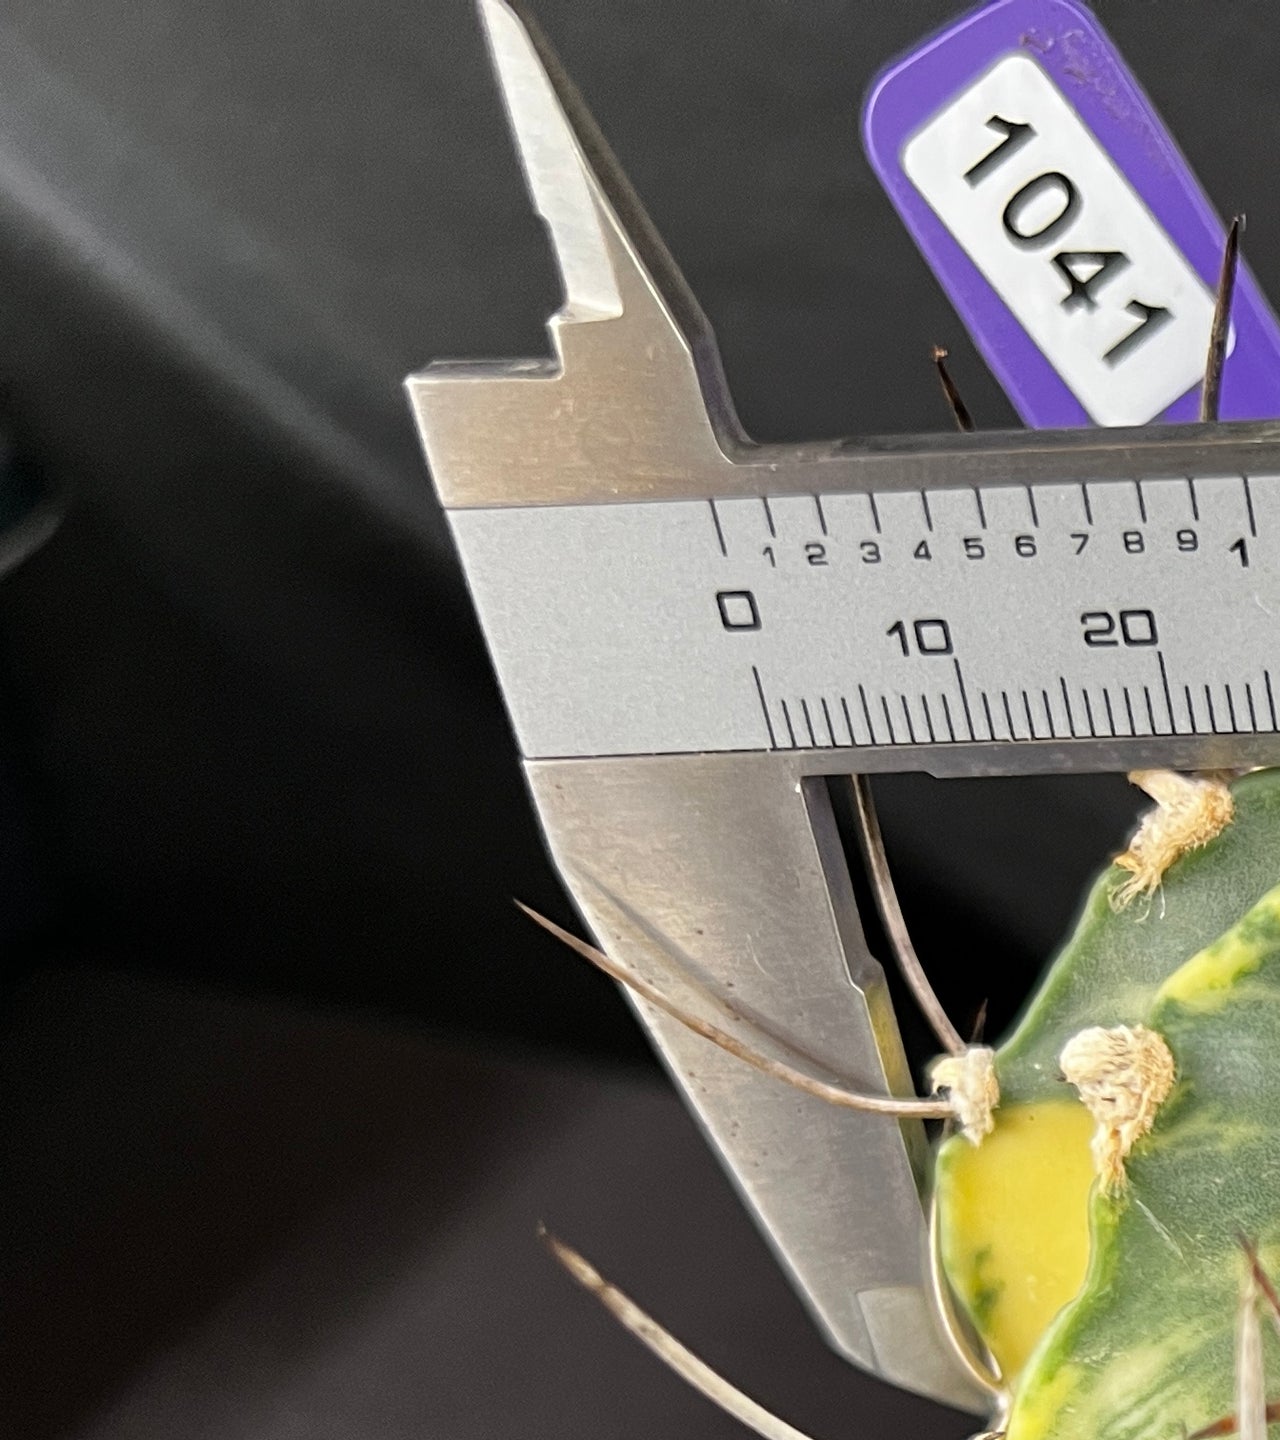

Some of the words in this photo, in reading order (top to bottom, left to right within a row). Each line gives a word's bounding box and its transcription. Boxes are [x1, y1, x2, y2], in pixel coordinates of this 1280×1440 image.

[963, 115, 1175, 369] 1041
[762, 545, 776, 568] 1
[804, 541, 829, 567] 2
[859, 540, 882, 564] 3
[912, 539, 933, 561] 4
[962, 536, 986, 561] 5
[1014, 534, 1038, 558] 6
[1069, 533, 1090, 556] 7
[1122, 530, 1146, 554] 8
[1175, 528, 1199, 552] 9
[1228, 537, 1250, 568] 1
[714, 589, 763, 633] 0
[885, 618, 954, 658] 10
[1079, 608, 1159, 648] 20
